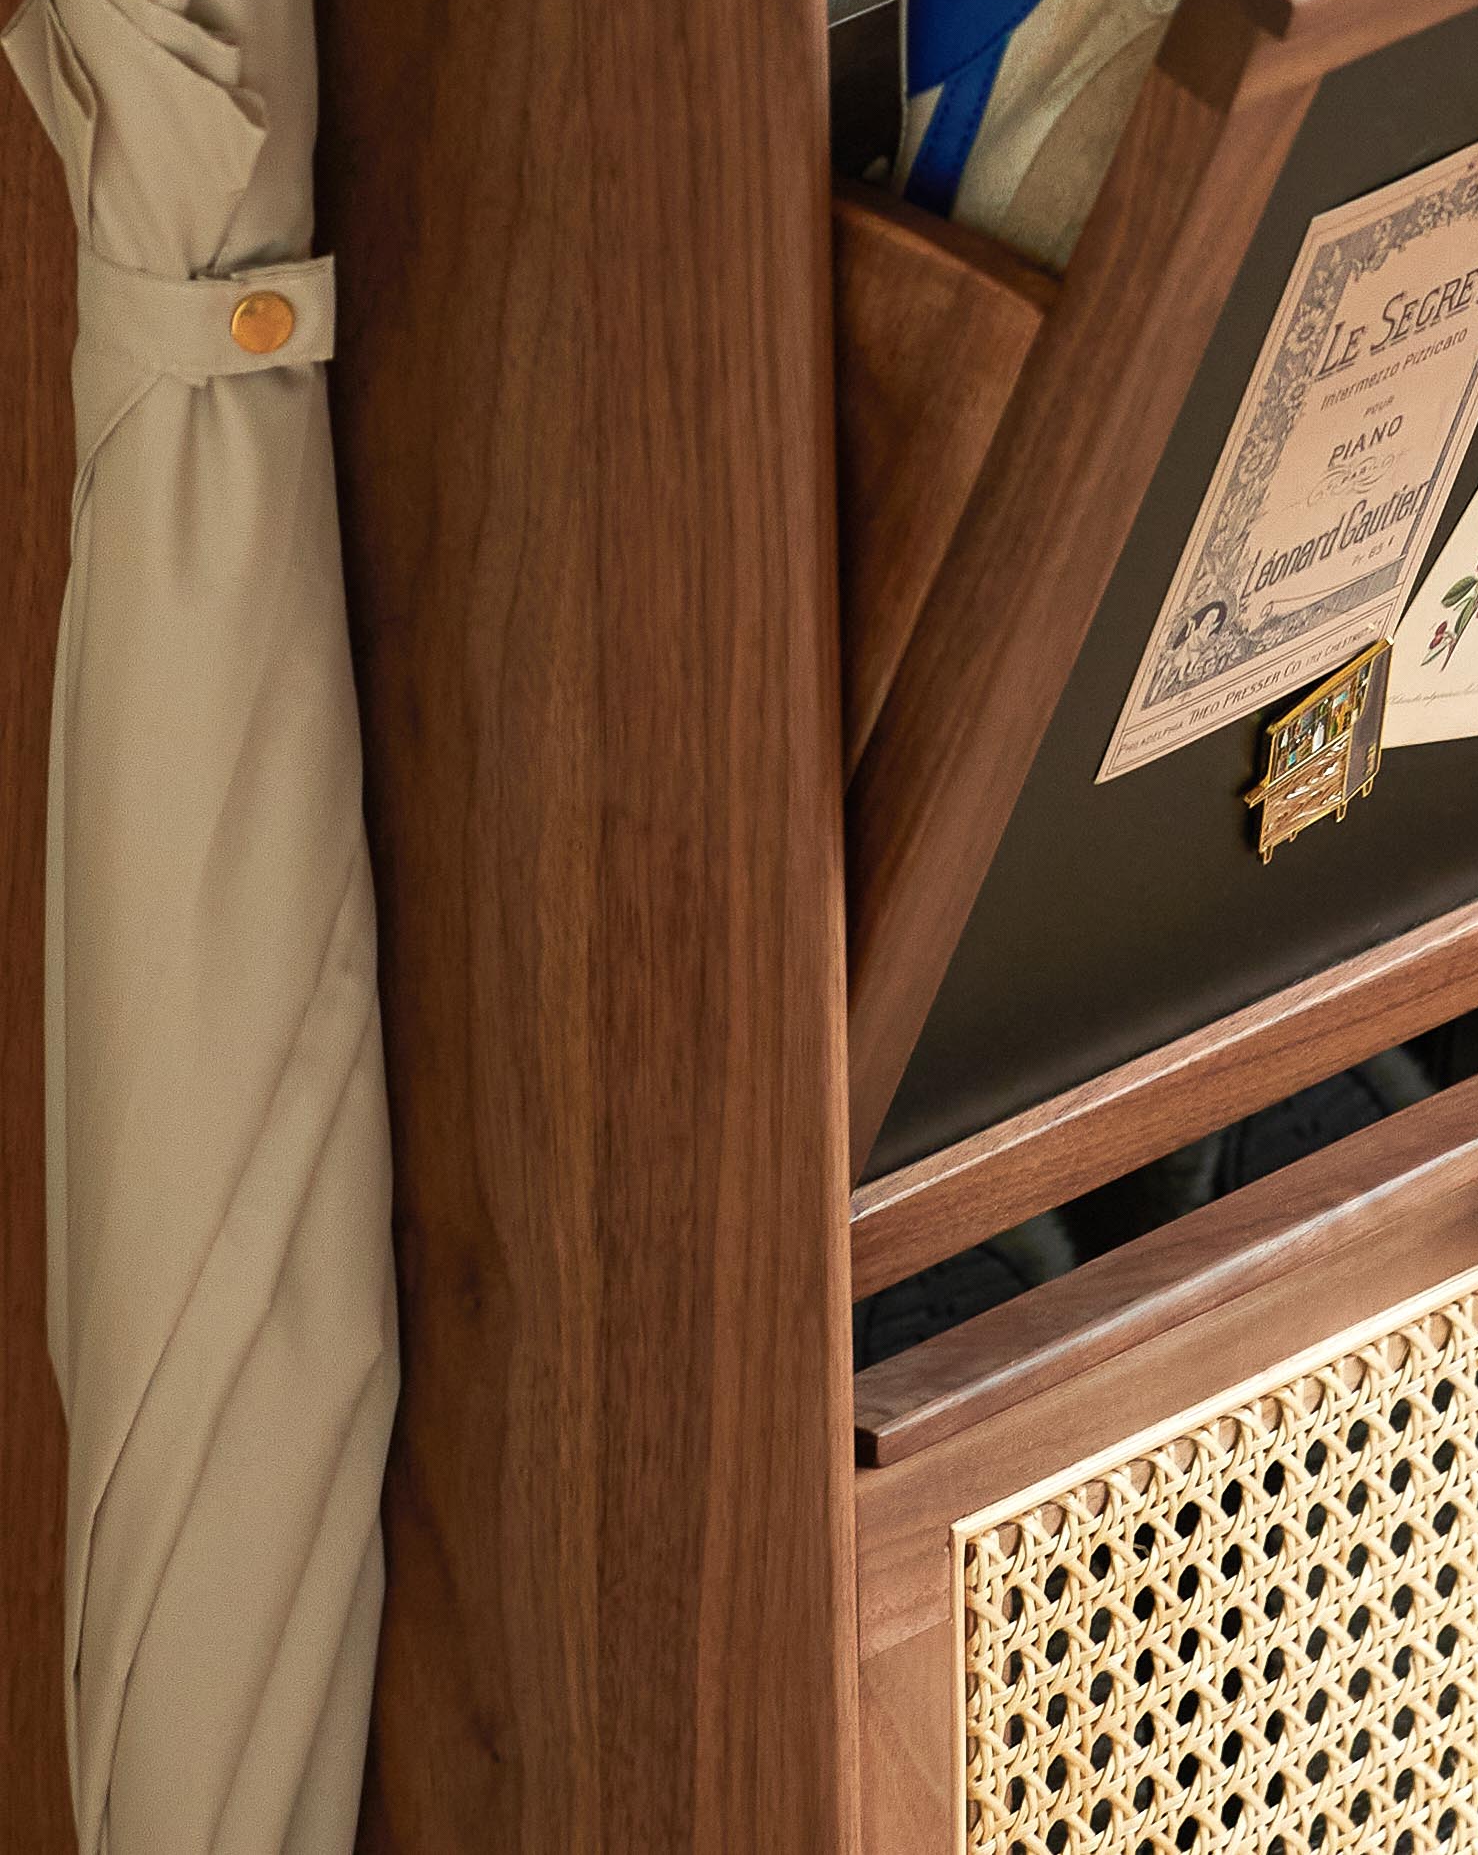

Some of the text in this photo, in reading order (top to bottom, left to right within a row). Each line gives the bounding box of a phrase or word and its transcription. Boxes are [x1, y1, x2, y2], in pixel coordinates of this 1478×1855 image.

[1317, 320, 1367, 377] LE
[1320, 328, 1468, 412] Intermezzo Pizzicato
[1328, 414, 1404, 468] PIANO
